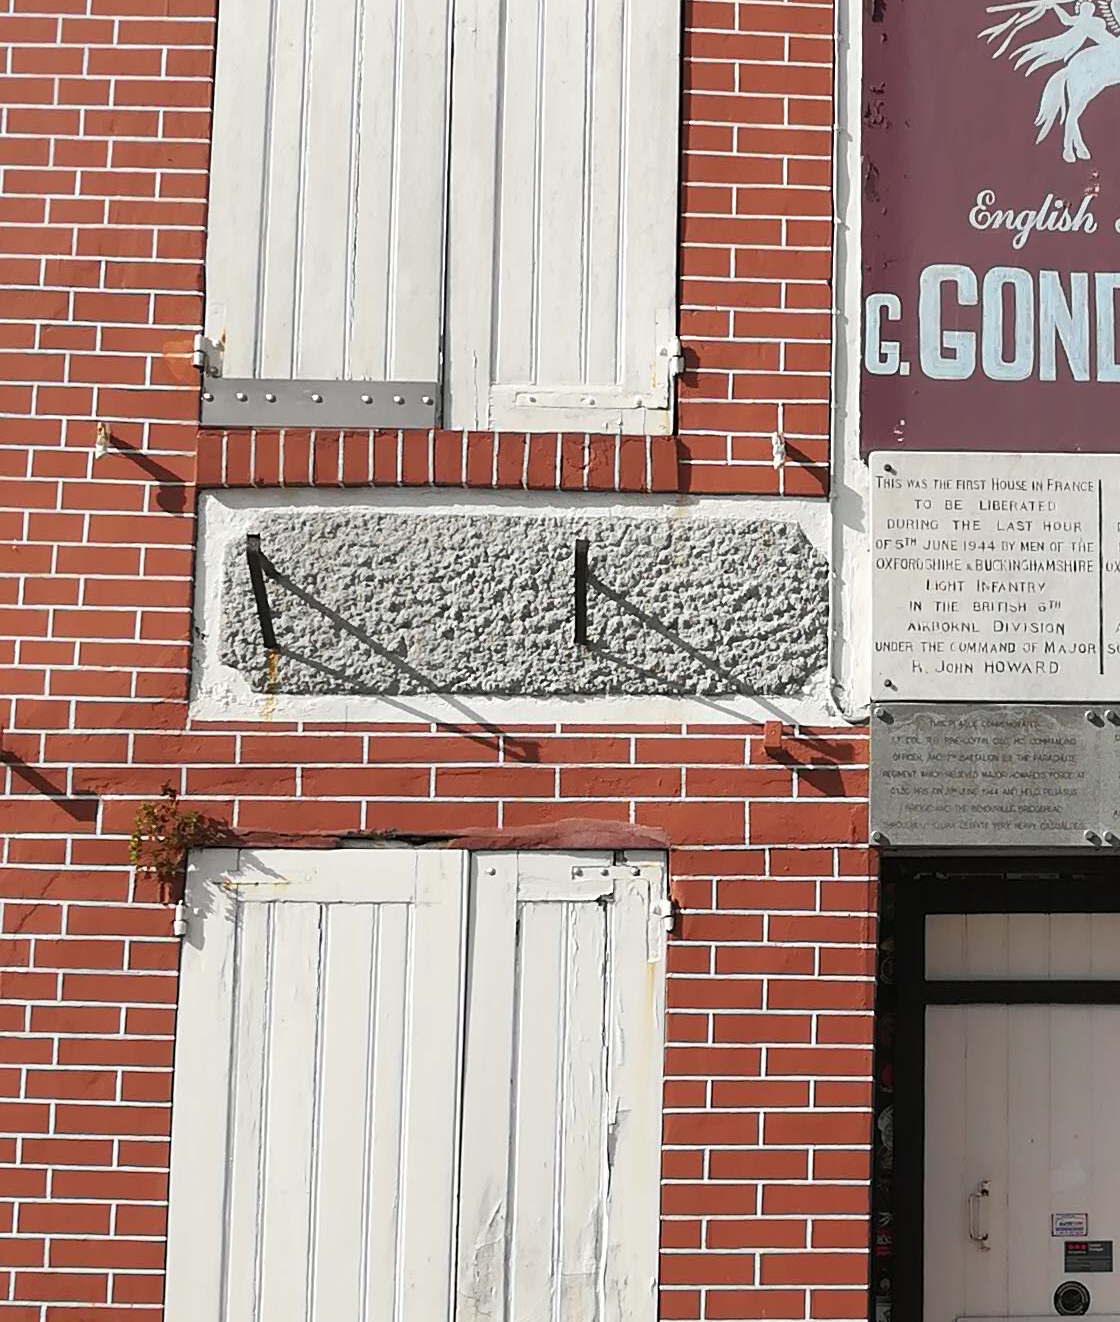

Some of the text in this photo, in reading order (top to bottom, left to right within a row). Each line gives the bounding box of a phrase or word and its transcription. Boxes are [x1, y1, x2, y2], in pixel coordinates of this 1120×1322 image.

[968, 188, 1098, 250] English
[864, 291, 912, 377] G.
[876, 476, 1094, 492] THIS WAS THE FIRST HOUSE IN FRANCE
[914, 499, 1056, 511] TO BE LIBERATED
[887, 519, 1082, 532] DURING THE LAST HOUR
[875, 539, 890, 549] OF
[923, 540, 958, 551] JUNE
[964, 540, 996, 551] 1944
[1001, 540, 1016, 552] BY
[1020, 540, 1044, 552] MEN
[1050, 541, 1064, 553] OF
[1071, 541, 1094, 553] THE
[876, 557, 962, 571] OXFORDSHIRE
[976, 558, 1094, 573] BUCKINGHAMSHIRE
[926, 578, 1046, 593] LIGHT INFANTRY
[910, 600, 922, 612] IN
[934, 601, 958, 612] THE
[974, 601, 1026, 613] BRITISH
[908, 620, 1065, 635] AIRBORNE DIVISION
[876, 641, 1096, 654] UNDER THE COMMAND OF MAJOR
[912, 659, 1059, 675] R. JOHN HOWARD
